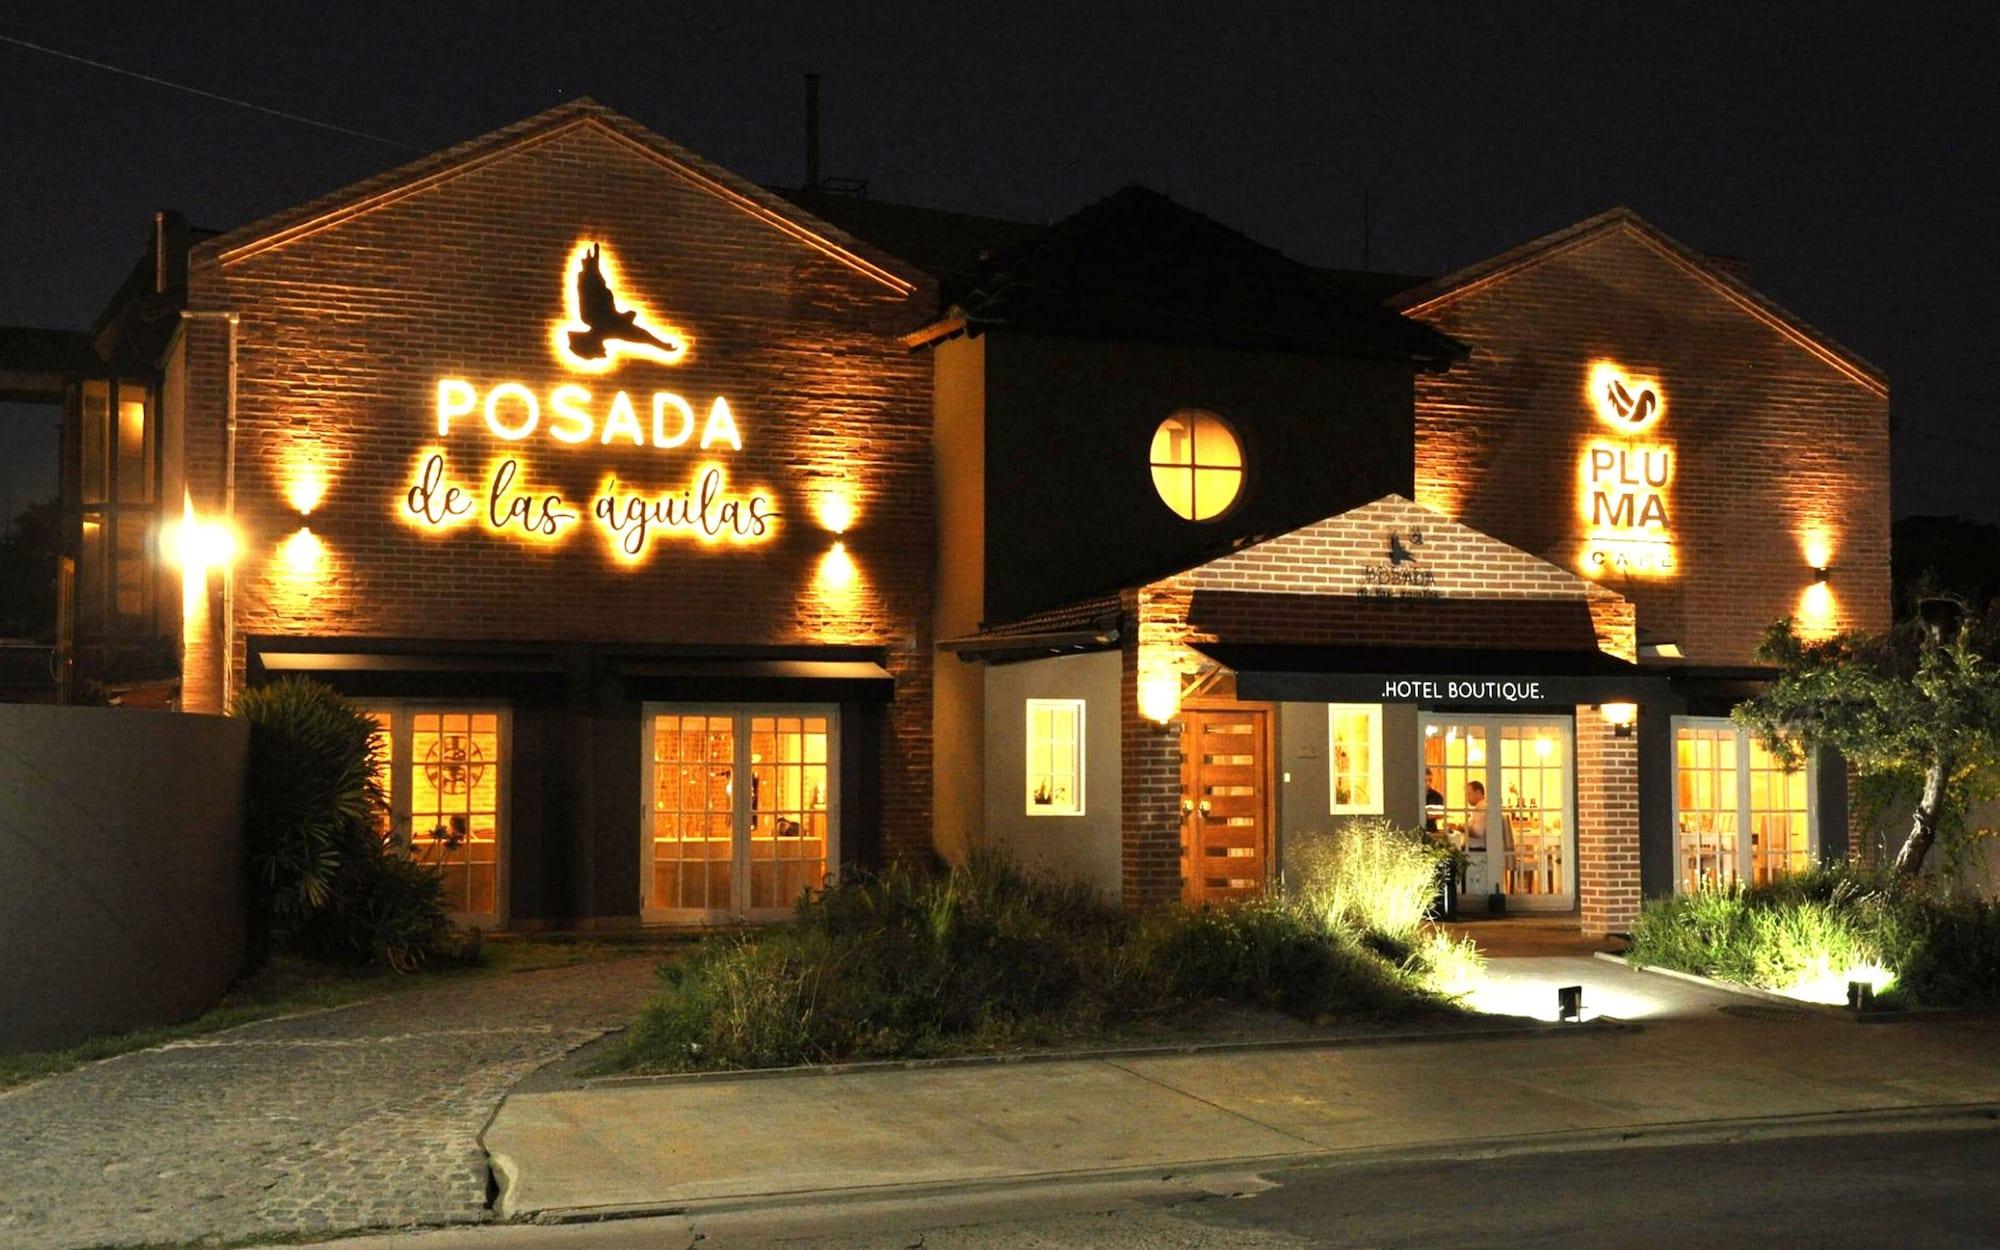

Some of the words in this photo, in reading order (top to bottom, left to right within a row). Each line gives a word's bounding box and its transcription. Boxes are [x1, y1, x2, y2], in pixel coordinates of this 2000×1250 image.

[437, 378, 743, 451] POSADA
[1592, 448, 1668, 487] PLU
[407, 454, 473, 525] de
[489, 459, 576, 536] las
[595, 468, 783, 555] águilas
[1592, 491, 1670, 529] MA
[1448, 682, 1545, 702] BOUTIQUE.
